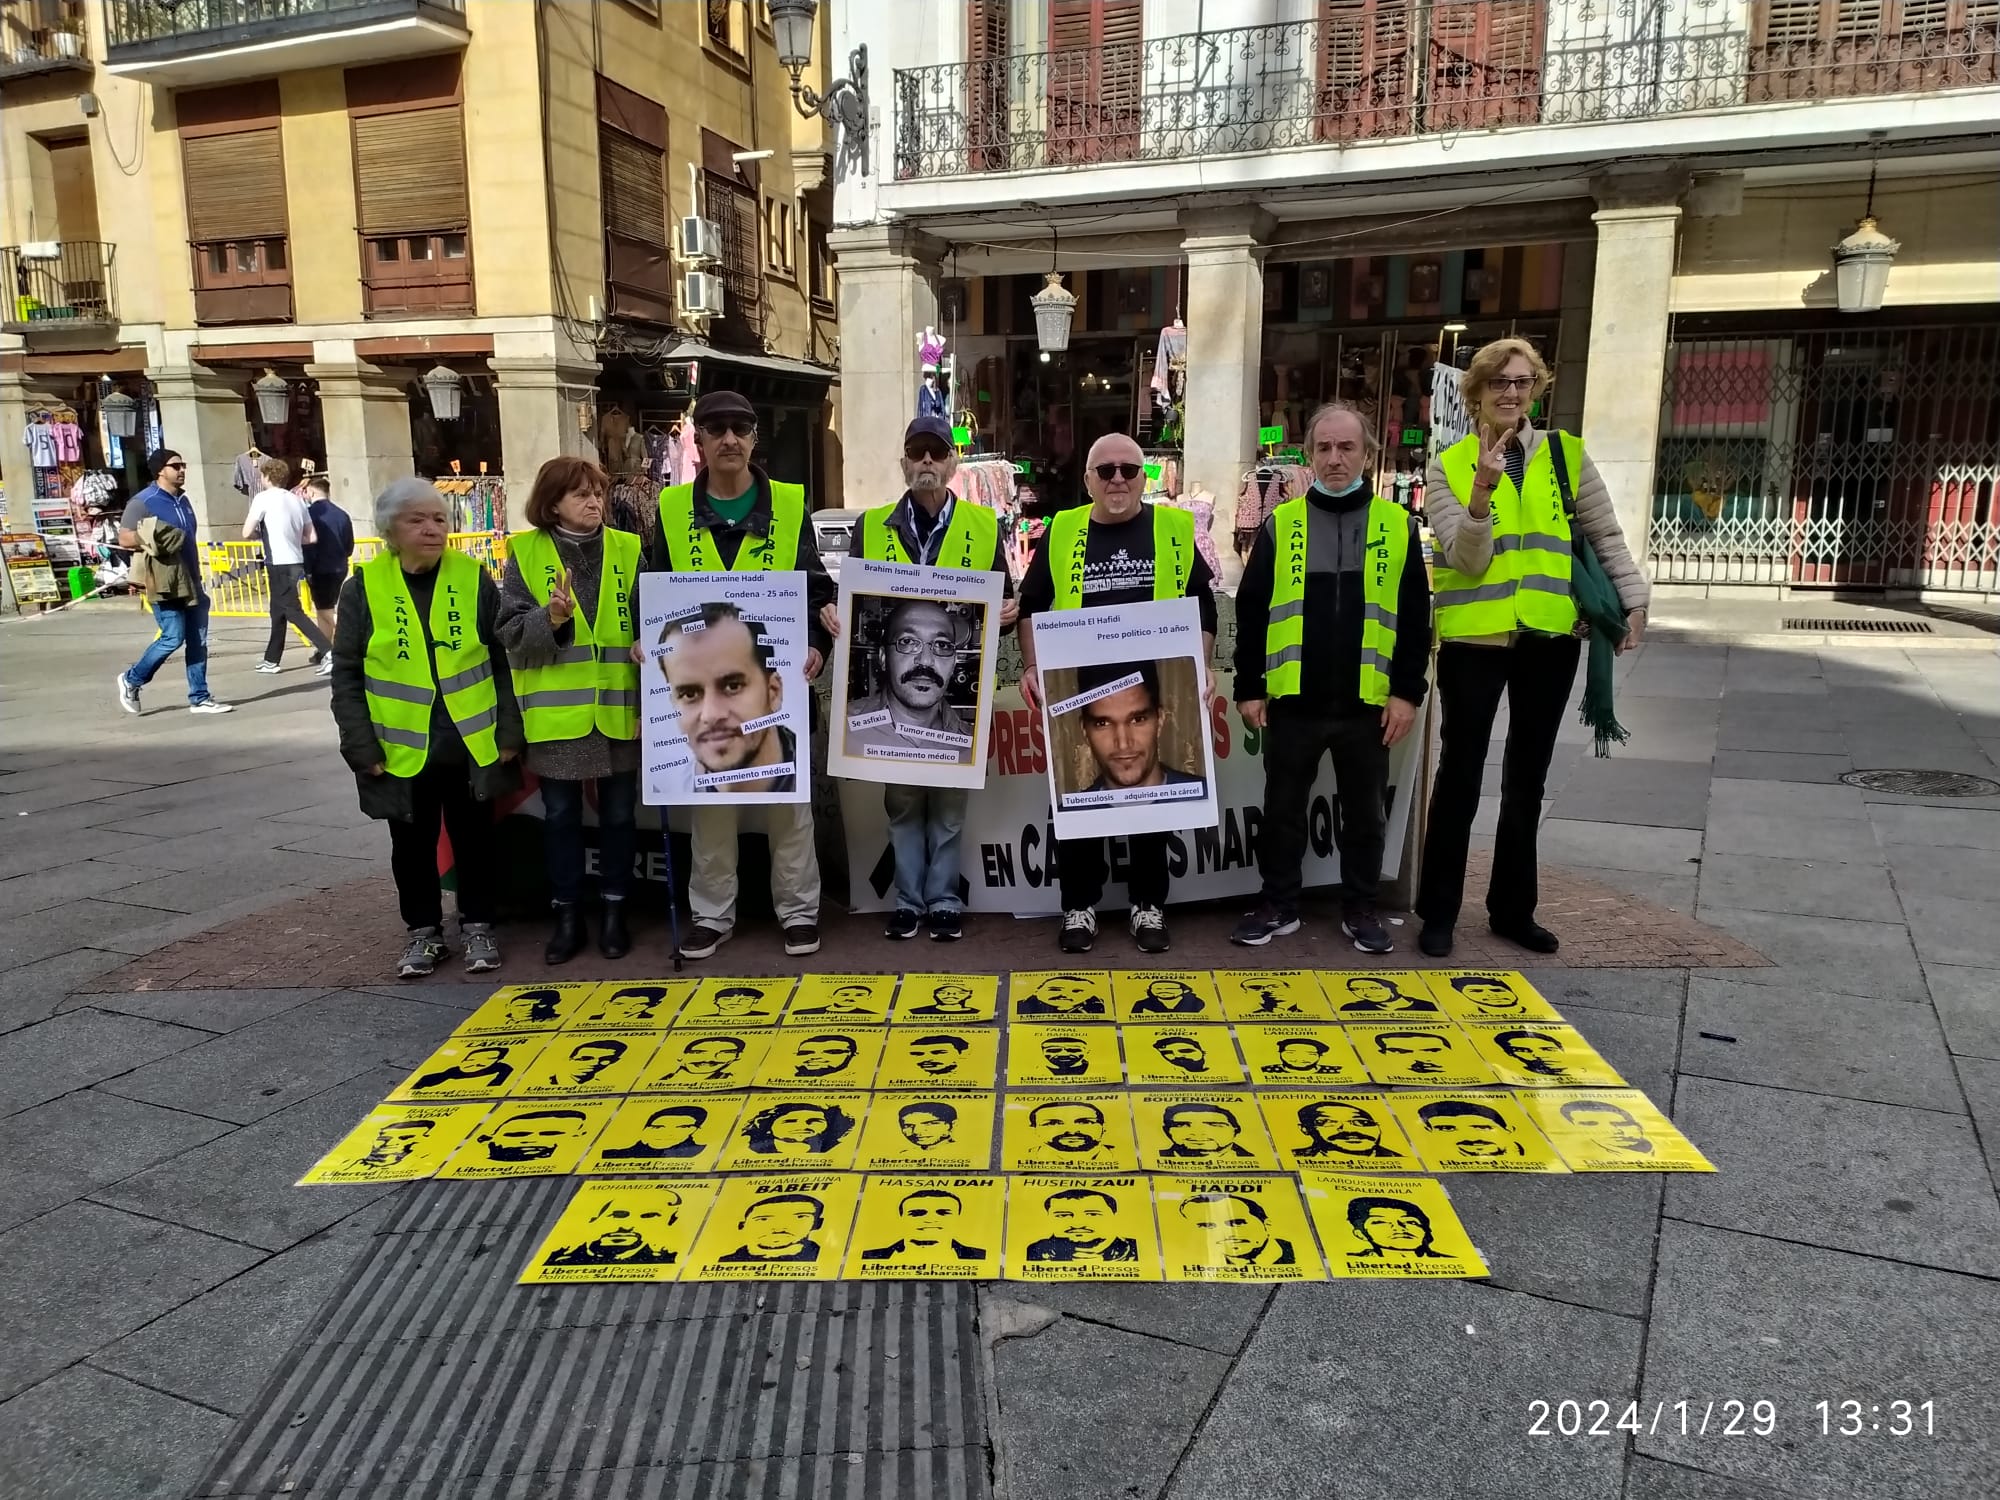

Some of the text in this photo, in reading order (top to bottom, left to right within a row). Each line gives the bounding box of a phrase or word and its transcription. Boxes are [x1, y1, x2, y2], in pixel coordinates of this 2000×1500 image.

[687, 509, 703, 571] SAHAR
[762, 510, 779, 571] LIBR
[1290, 519, 1304, 586] SAHARA
[1376, 522, 1391, 587] LIBRE
[1070, 528, 1088, 595] SAHARA
[864, 563, 893, 574] Brahim
[894, 568, 920, 577] Ismaili
[932, 572, 954, 581] Preso
[669, 575, 710, 583] Mohamed
[711, 575, 740, 583] Lamine
[724, 590, 760, 599] Condena
[779, 589, 798, 597] años
[890, 585, 957, 596] cadena perpetua
[613, 564, 629, 632] LIBRE
[447, 584, 462, 651] LIBRE
[664, 604, 701, 621] infectado
[739, 613, 796, 623] articulaciones
[394, 596, 410, 660] SAHARA
[684, 622, 705, 633] dolor
[1036, 619, 1086, 630] Albdelmoula
[1096, 615, 1121, 625] Hafidi
[1097, 632, 1120, 640] Preso
[1159, 626, 1169, 634] 10
[1170, 625, 1190, 633] años
[758, 637, 790, 646] espalda
[650, 645, 674, 657] fiebre
[767, 658, 791, 667] visión
[649, 685, 671, 696] Asma
[1052, 675, 1140, 714] Sin tratamiento médico
[649, 710, 682, 724] Enuresis
[744, 712, 791, 732] Aislamiento
[851, 714, 887, 728] Se asfixia
[899, 724, 924, 736] Tumor
[937, 731, 944, 740] el
[945, 734, 969, 746] pecho
[653, 736, 688, 749] intestino
[880, 749, 926, 759] tratamiento
[927, 751, 956, 761] médico
[649, 756, 689, 773] estomacal
[697, 766, 791, 786] Sin tratamiento médico
[1066, 794, 1114, 805] Tuberculosis
[1124, 791, 1158, 801] adquirida
[1170, 789, 1177, 797] la
[1178, 787, 1200, 796] cárcel
[980, 843, 1016, 888] EN
[745, 1177, 811, 1186] MOHAMED
[879, 1179, 994, 1187] HASSAN DAH
[1023, 1179, 1136, 1187] HUSEIN ZAUI
[1317, 1176, 1377, 1187] LAAROUSSI
[754, 1182, 833, 1194] BABEIT
[1191, 1184, 1263, 1193] HADDI
[1334, 1185, 1385, 1194] ESSALEM
[542, 1266, 609, 1275] Libertad
[701, 1263, 820, 1272] Libertad Presos
[861, 1263, 979, 1271] Libertad Presos
[1022, 1264, 1141, 1272] Libertad Presos
[1183, 1264, 1303, 1273] Libertad Presos
[1346, 1261, 1412, 1269] Libertad
